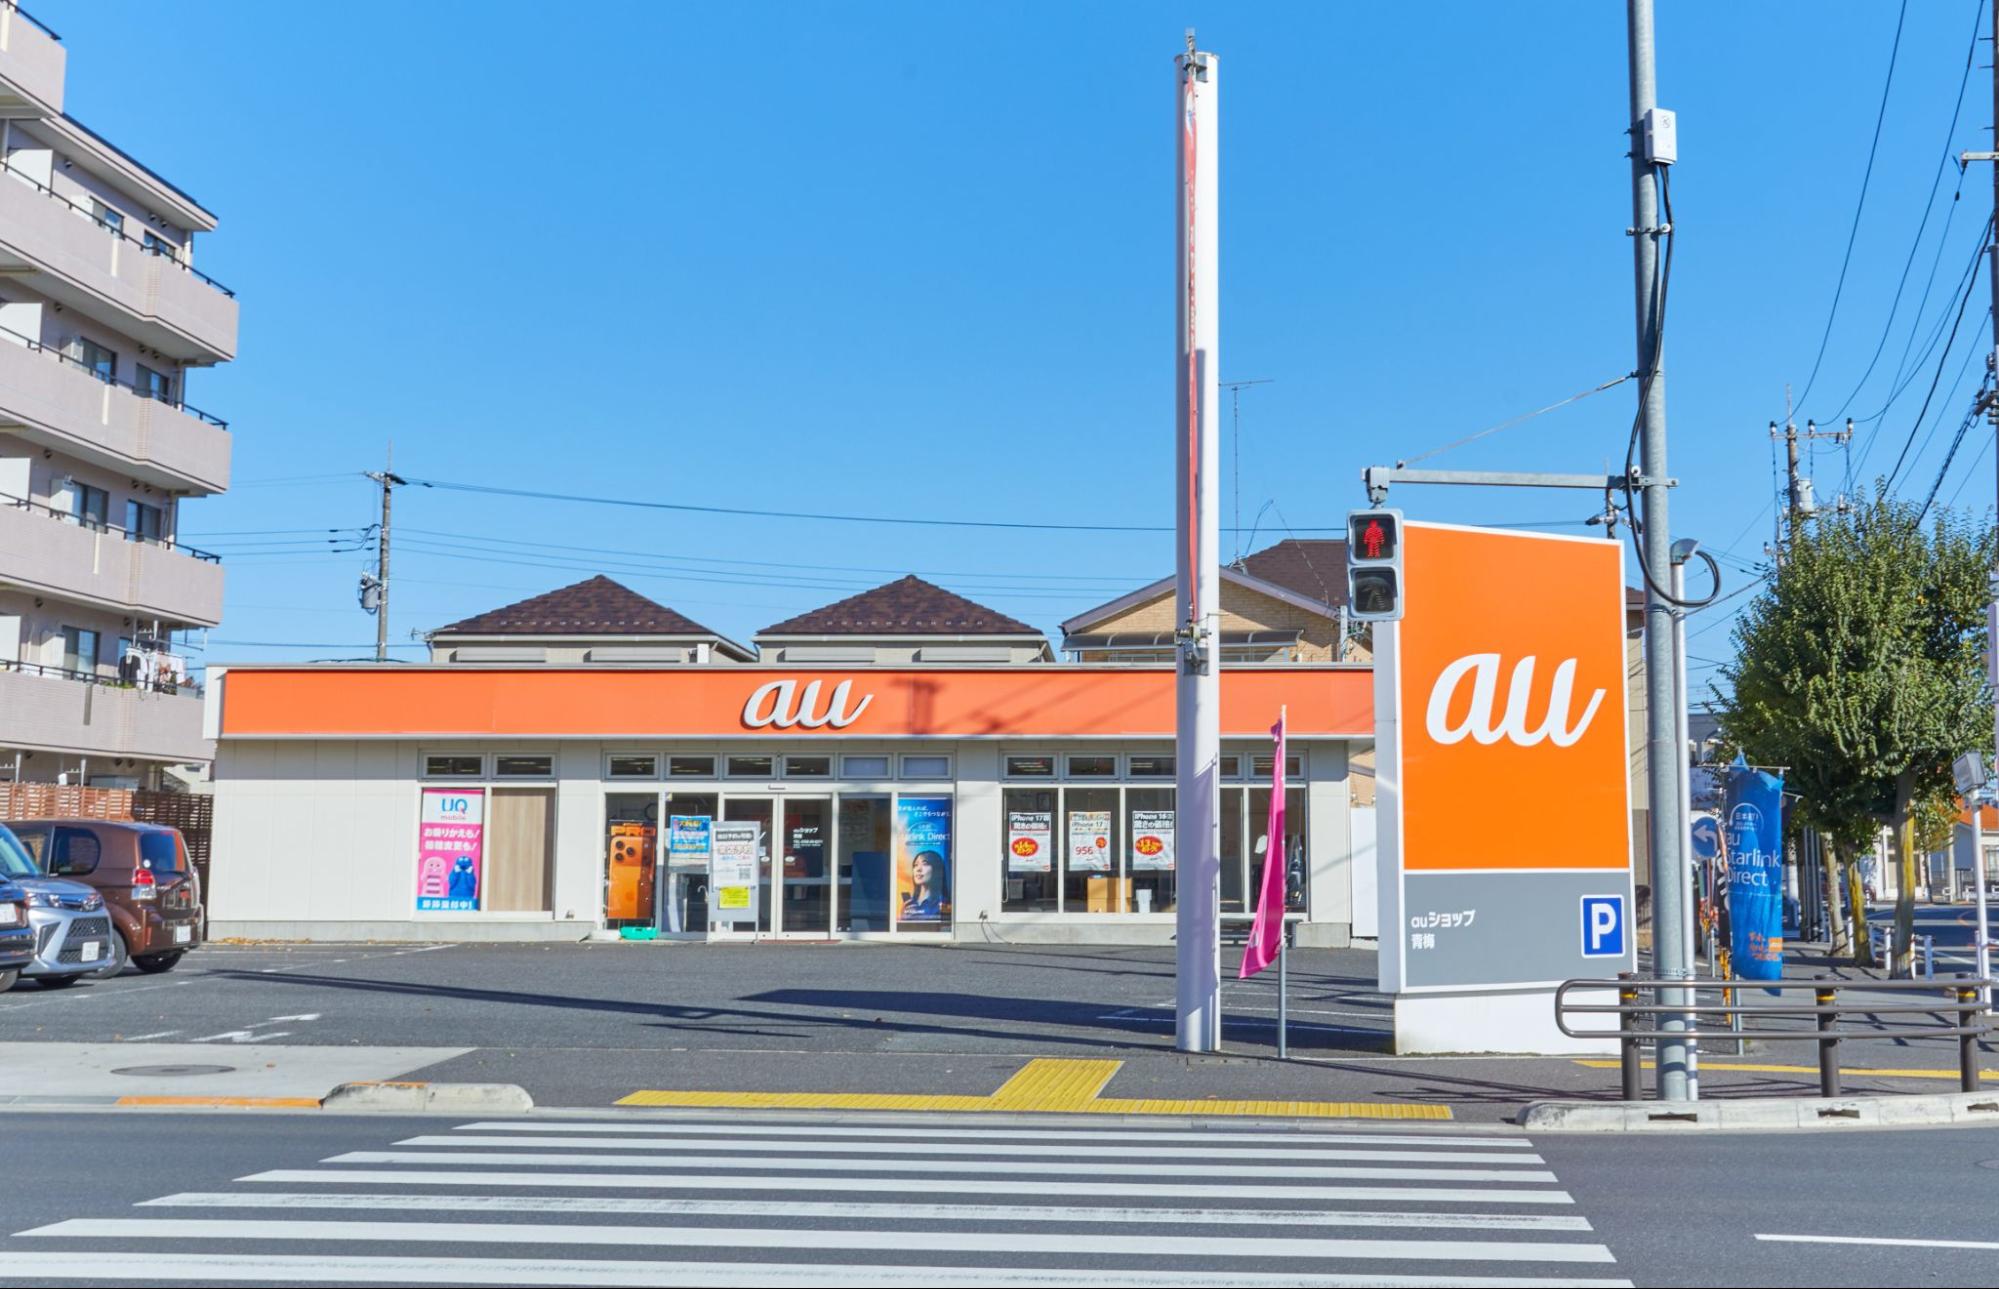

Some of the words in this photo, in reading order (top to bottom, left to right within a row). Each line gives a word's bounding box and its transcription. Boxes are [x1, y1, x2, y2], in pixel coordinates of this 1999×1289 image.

[743, 679, 874, 728] au
[1426, 653, 1606, 747] au
[441, 798, 468, 814] UQ
[1727, 832, 1741, 846] au
[1727, 866, 1769, 887] Direct
[1410, 909, 1476, 929] auショップ
[1591, 903, 1617, 950] P
[1411, 933, 1436, 950] 青梅
